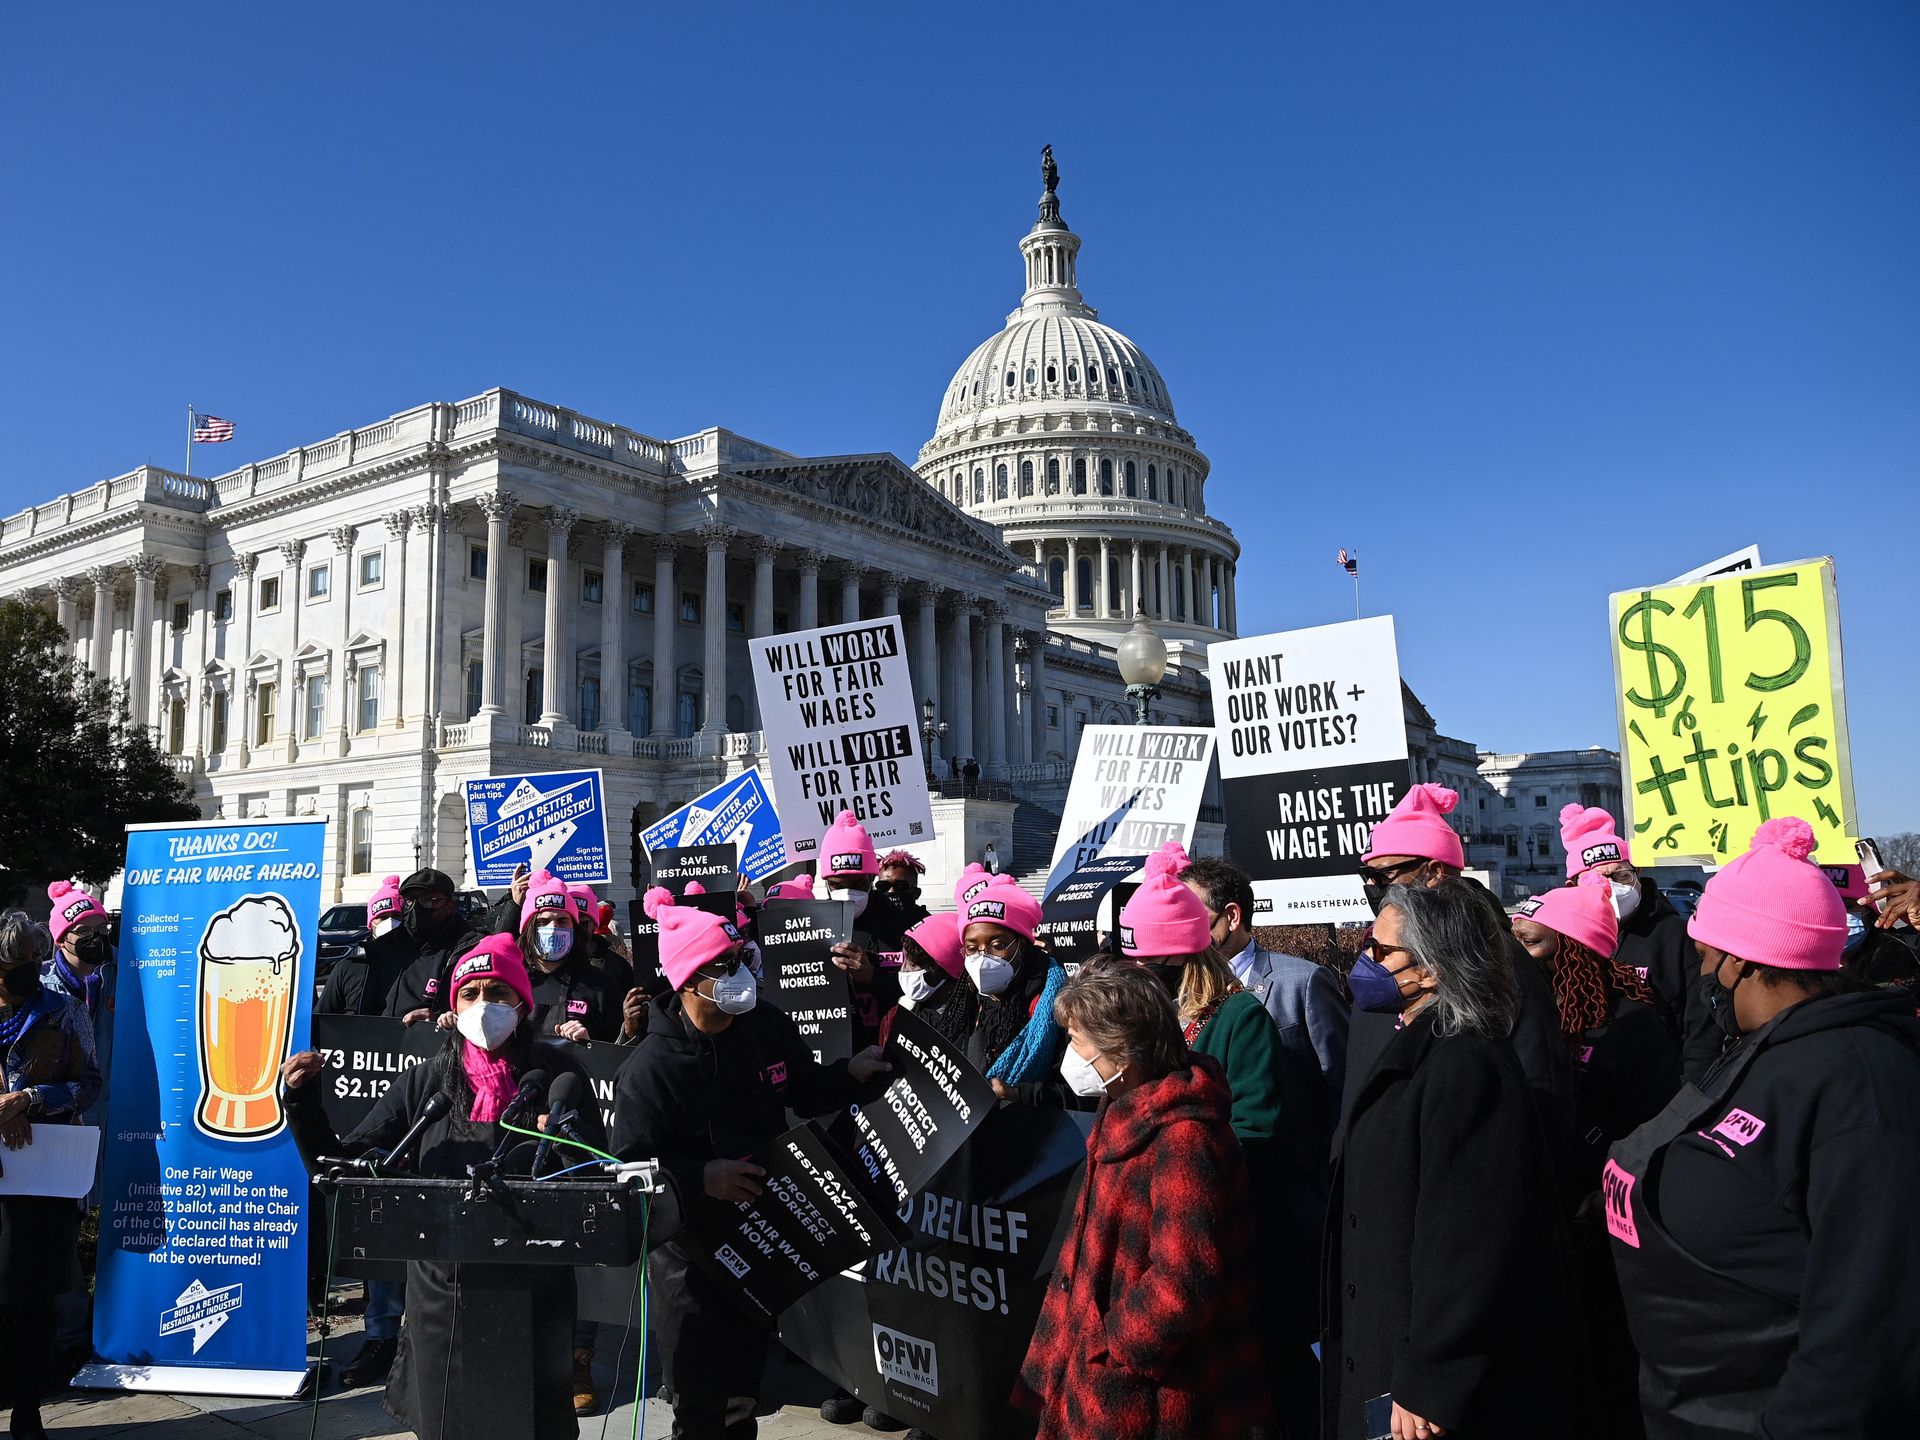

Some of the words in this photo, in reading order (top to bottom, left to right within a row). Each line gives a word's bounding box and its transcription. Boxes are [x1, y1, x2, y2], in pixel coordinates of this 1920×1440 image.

[765, 641, 820, 673] WILL
[826, 628, 892, 664] WORK
[1619, 572, 1811, 718] $15
[783, 670, 824, 701] FOR
[833, 661, 883, 694] FAIR
[1223, 654, 1283, 690] WANT
[800, 692, 877, 729] WAGES
[1227, 690, 1268, 723] OUR
[1274, 680, 1338, 717] WORK
[1346, 684, 1365, 702] +
[1092, 734, 1134, 757] WILL
[1143, 735, 1202, 759] WORK
[1231, 725, 1272, 757] OUR
[1277, 713, 1358, 752] VOTES?
[788, 739, 842, 772] WILL
[848, 728, 904, 764] VOTE
[801, 769, 842, 800] FOR
[850, 760, 901, 792] FAIR
[1095, 760, 1130, 782] FOR
[1137, 760, 1183, 784] FAIR
[469, 783, 482, 791] Fair
[485, 782, 506, 791] wage
[470, 792, 486, 802] plus
[487, 790, 504, 799] tips.
[517, 785, 530, 798] DC
[1100, 785, 1166, 811] WAGES
[504, 792, 536, 811] COMMITTEE
[817, 791, 894, 826] WAGES
[1278, 786, 1344, 824] RAISE
[1350, 781, 1395, 817] THE
[484, 820, 541, 854] RESTAURANT
[544, 797, 591, 826] INDUSTRY
[498, 816, 525, 835] BUILD
[528, 811, 534, 821] A
[537, 793, 573, 818] BETTER
[689, 810, 701, 825] DC
[712, 797, 742, 833] BETTER
[722, 793, 758, 838] INDUSTRY
[645, 830, 659, 841] Fair
[659, 818, 679, 833] wage
[649, 837, 664, 851] plus
[664, 827, 680, 840] tips.
[681, 814, 708, 842] COMMITTEE
[1077, 821, 1122, 845] WILL
[1129, 822, 1177, 848] VOTE
[168, 833, 238, 857] THANKS
[243, 831, 278, 849] DC!
[758, 838, 772, 848] Sign
[796, 840, 814, 849] OFW
[1266, 827, 1330, 861] WAGE
[1583, 844, 1616, 861] OFW
[556, 863, 592, 872] Initiative
[558, 855, 582, 864] petition
[681, 856, 708, 866] SAVE
[745, 848, 768, 864] petition
[745, 851, 778, 872] Initiative
[832, 855, 861, 866] OFW
[127, 868, 163, 886] ONE
[165, 867, 202, 884] FAIR
[206, 864, 255, 883] WAGE
[257, 862, 320, 881] AHEAD.
[657, 865, 732, 878] RESTAURANTS.
[964, 881, 986, 902] OFW
[1056, 891, 1094, 902] WORKERS.
[1066, 882, 1104, 891] PROTECT
[536, 895, 564, 905] OFW
[969, 902, 1004, 914] OFW
[1288, 898, 1367, 909] #RAISETHEWAG
[132, 924, 179, 935] signatures
[138, 913, 179, 923] Collected
[785, 917, 811, 929] SAVE
[1037, 923, 1051, 934] ONE
[1052, 921, 1069, 933] FAIR
[1070, 920, 1094, 932] WAGE
[764, 928, 835, 946] RESTAURANTS.
[1054, 936, 1076, 947] NOW.
[130, 958, 176, 970] signatures
[149, 948, 176, 959] 26,205
[455, 954, 490, 977] OFW
[157, 968, 175, 979] goal
[782, 961, 824, 975] PROTECT
[779, 975, 830, 989] WORKERS.
[791, 1010, 814, 1021] FAIR
[815, 1007, 847, 1020] WAGE
[930, 1045, 962, 1083] SAVE
[896, 1033, 971, 1125] RESTAURANTS.
[897, 1077, 938, 1136] PROTECT
[883, 1086, 926, 1154] WORKERS.
[1724, 1113, 1758, 1137] OFW
[118, 1131, 166, 1141] signatures
[850, 1103, 870, 1133] ONE
[866, 1130, 889, 1162] FAIR
[883, 1158, 909, 1201] WAGE
[858, 1144, 881, 1183] NOW.
[165, 1167, 189, 1179] One
[193, 1167, 217, 1180] Fair
[220, 1168, 253, 1182] Wage
[128, 1183, 182, 1198] (Initiative
[186, 1184, 206, 1198] 82)
[210, 1184, 230, 1197] will
[233, 1185, 248, 1197] be
[251, 1188, 265, 1197] on
[268, 1186, 288, 1198] the
[786, 1141, 872, 1247] RESTAURANTS.
[823, 1170, 857, 1210] SAVE
[113, 1201, 143, 1212] June
[147, 1201, 174, 1212] 2022
[177, 1202, 216, 1214] ballot,
[219, 1202, 241, 1214] and
[245, 1203, 264, 1214] the
[267, 1203, 299, 1215] Chair
[766, 1177, 826, 1247] WORKERS.
[780, 1175, 837, 1237] PROTECT
[113, 1217, 127, 1228] of
[130, 1217, 150, 1229] the
[153, 1217, 175, 1232] City
[178, 1218, 226, 1231] Council
[229, 1219, 250, 1231] has
[253, 1219, 298, 1235] already
[920, 1192, 1028, 1254] RELIEF
[122, 1233, 169, 1249] publicly
[172, 1235, 226, 1248] declared
[230, 1236, 253, 1248] that
[256, 1236, 265, 1248] it
[268, 1236, 289, 1249] will
[739, 1222, 772, 1259] NOW.
[748, 1211, 780, 1241] FAIR
[778, 1239, 819, 1281] WAGE
[149, 1253, 167, 1263] not
[170, 1252, 185, 1264] be
[188, 1252, 261, 1265] overturned!
[722, 1248, 748, 1272] OFW
[191, 1284, 200, 1292] DC
[875, 1247, 1009, 1315] RAISES!
[162, 1310, 205, 1331] RESTAURANT
[206, 1297, 240, 1316] INDUSTRY
[174, 1305, 194, 1318] BUILD
[202, 1293, 229, 1308] BETTER
[878, 1331, 931, 1374] OFW
[880, 1361, 893, 1371] ONE
[896, 1367, 911, 1378] FAIR
[913, 1373, 935, 1387] WAGE
